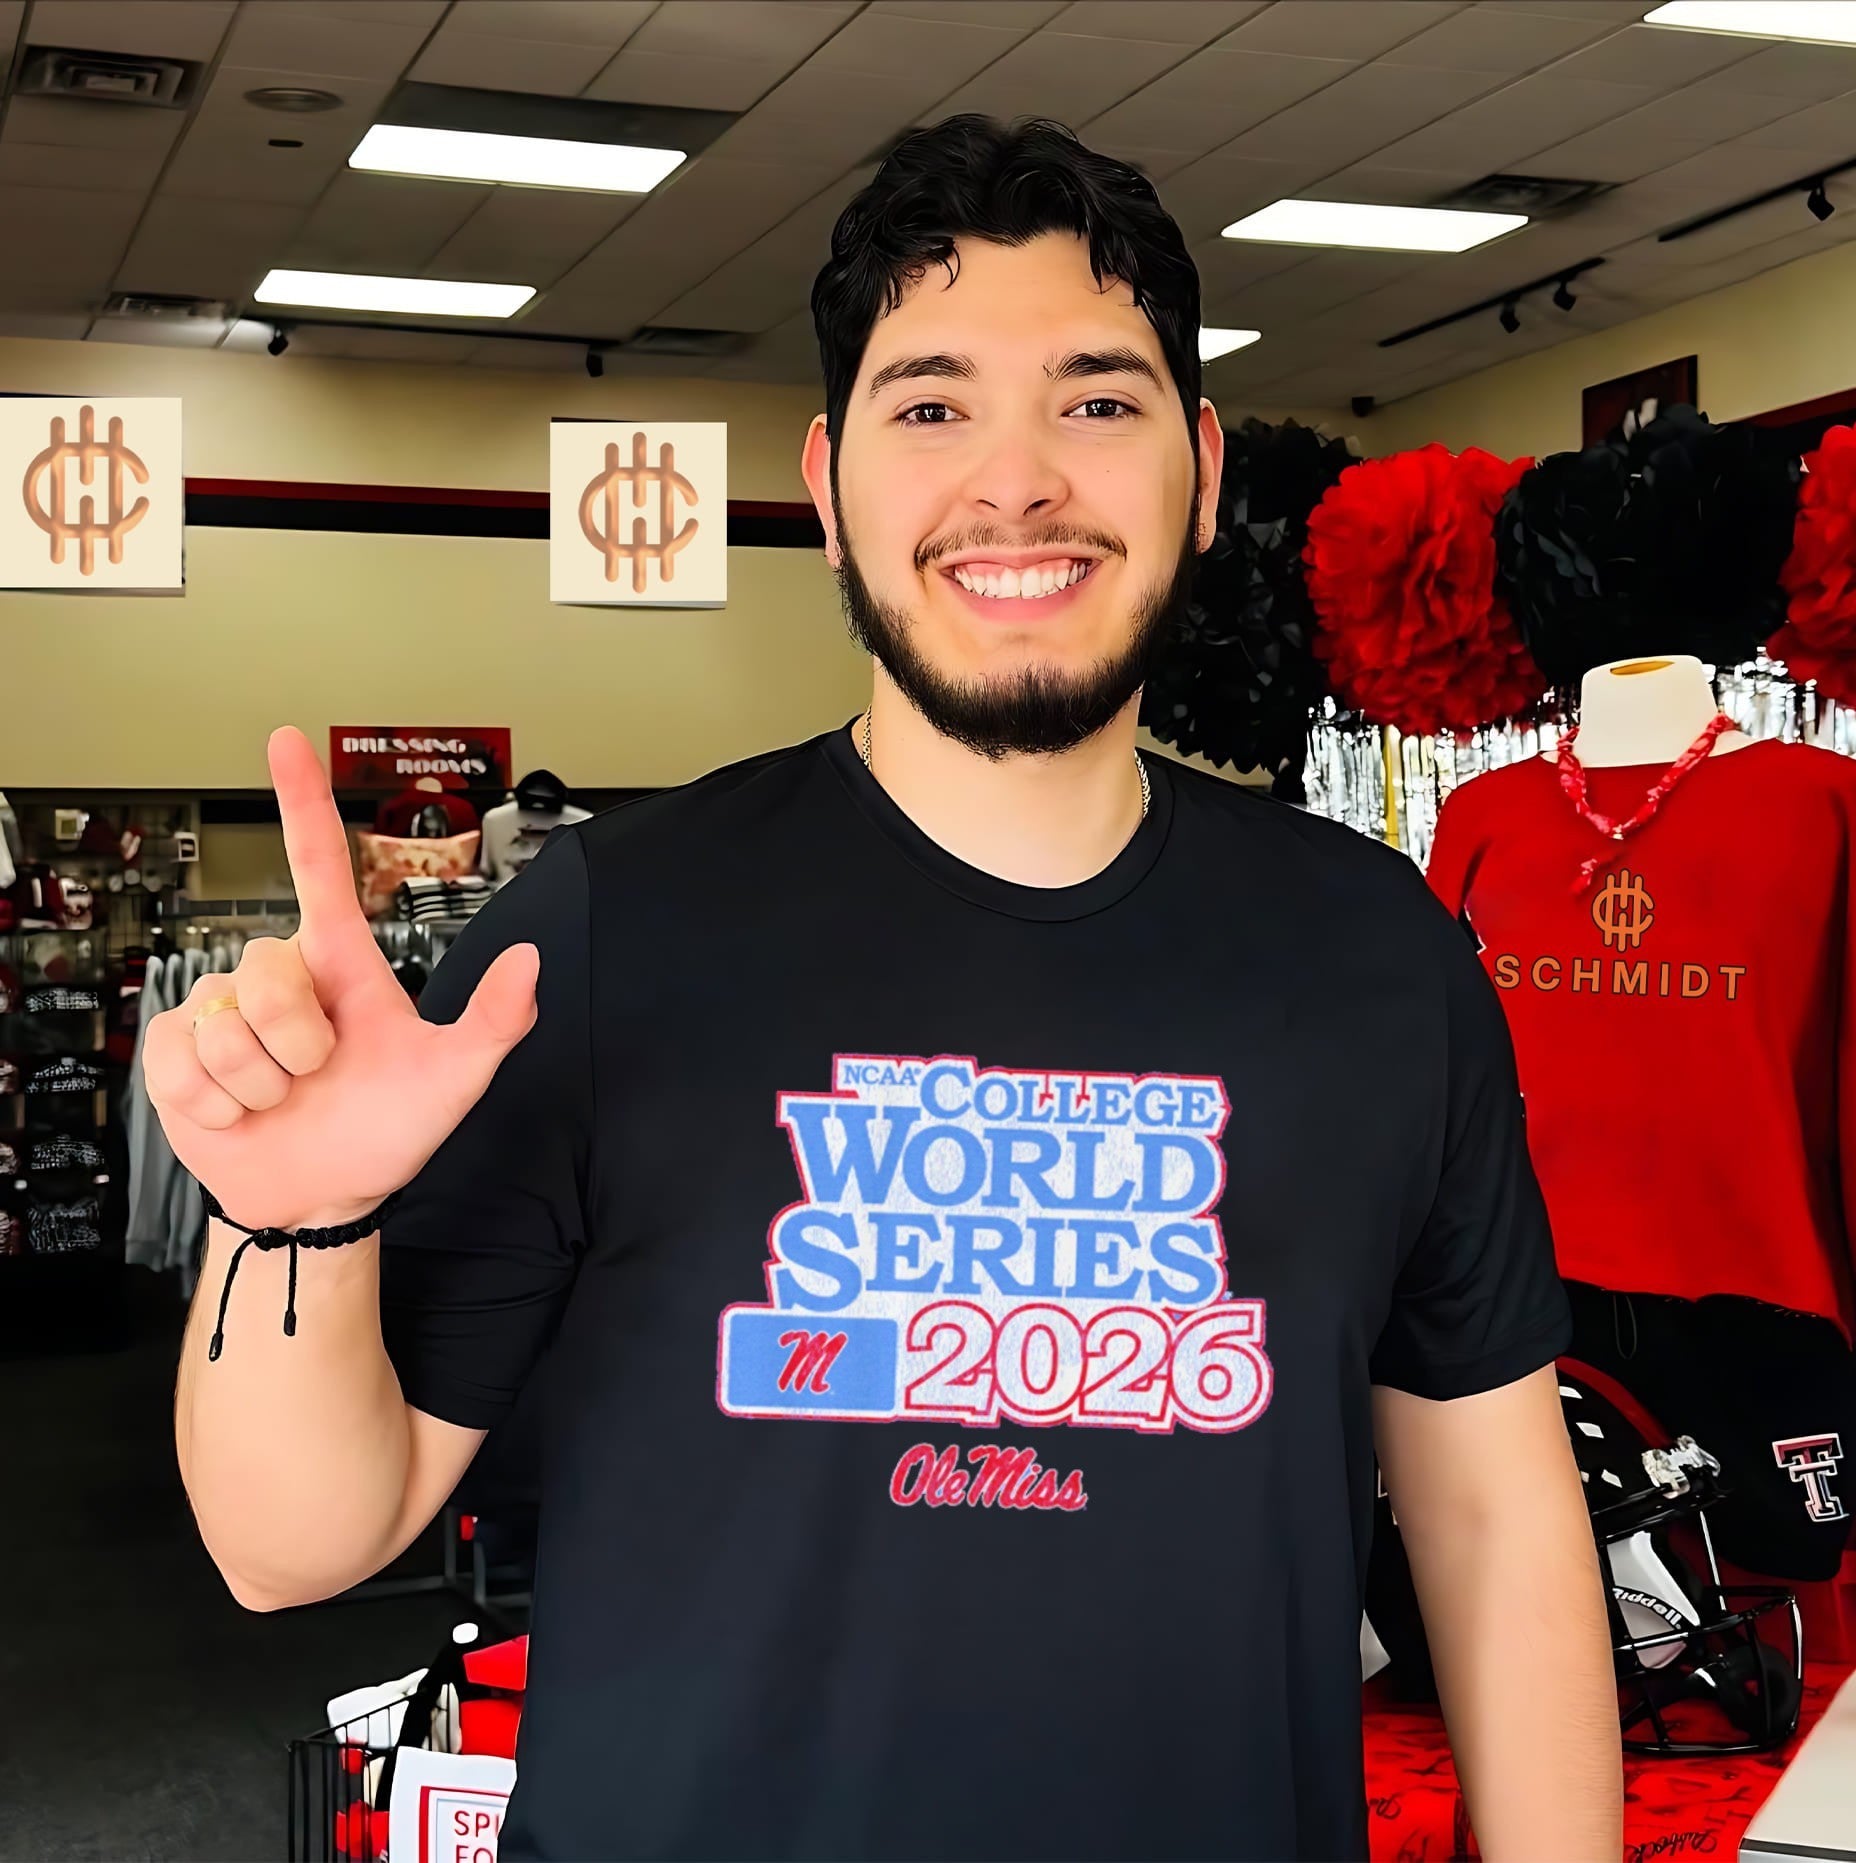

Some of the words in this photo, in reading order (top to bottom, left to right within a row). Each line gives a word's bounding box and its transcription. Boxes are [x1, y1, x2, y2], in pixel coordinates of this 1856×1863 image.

[342, 737, 467, 754] DRESSING
[396, 758, 488, 775] ROOMS
[1494, 954, 1747, 1000] SCHMIDT
[919, 1064, 1219, 1130] COLLEGE
[787, 1101, 1217, 1214] WORLD
[774, 1208, 1219, 1314] SERIES
[904, 1299, 1266, 1424] 2026
